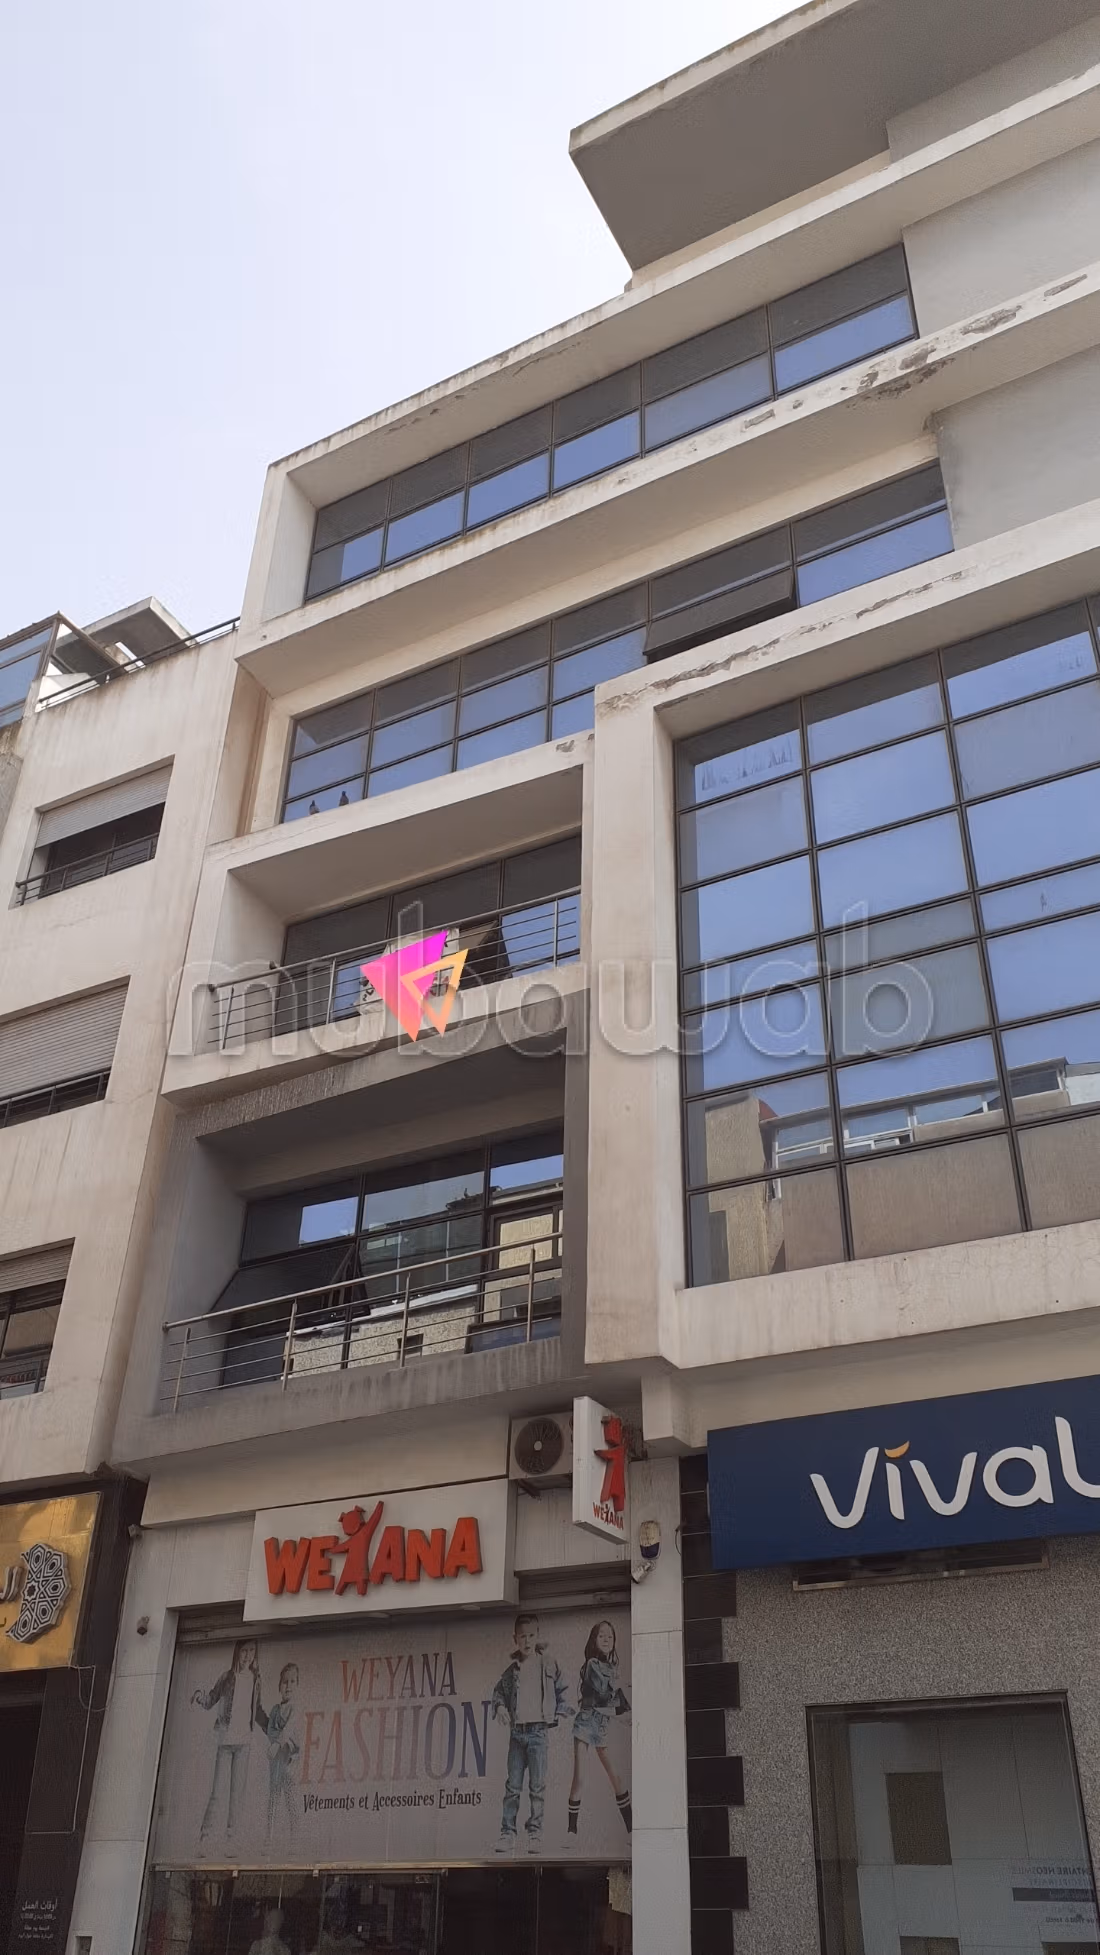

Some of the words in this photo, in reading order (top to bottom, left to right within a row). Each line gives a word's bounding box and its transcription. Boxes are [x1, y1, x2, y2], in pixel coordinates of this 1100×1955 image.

[264, 1501, 483, 1595] WEYANA
[341, 1652, 457, 1703] WEYANA
[300, 1701, 491, 1784] FASHION
[303, 1794, 355, 1813] Vêtements
[358, 1794, 369, 1810] et
[372, 1791, 435, 1812] Accessoires
[438, 1788, 482, 1809] Enfants
